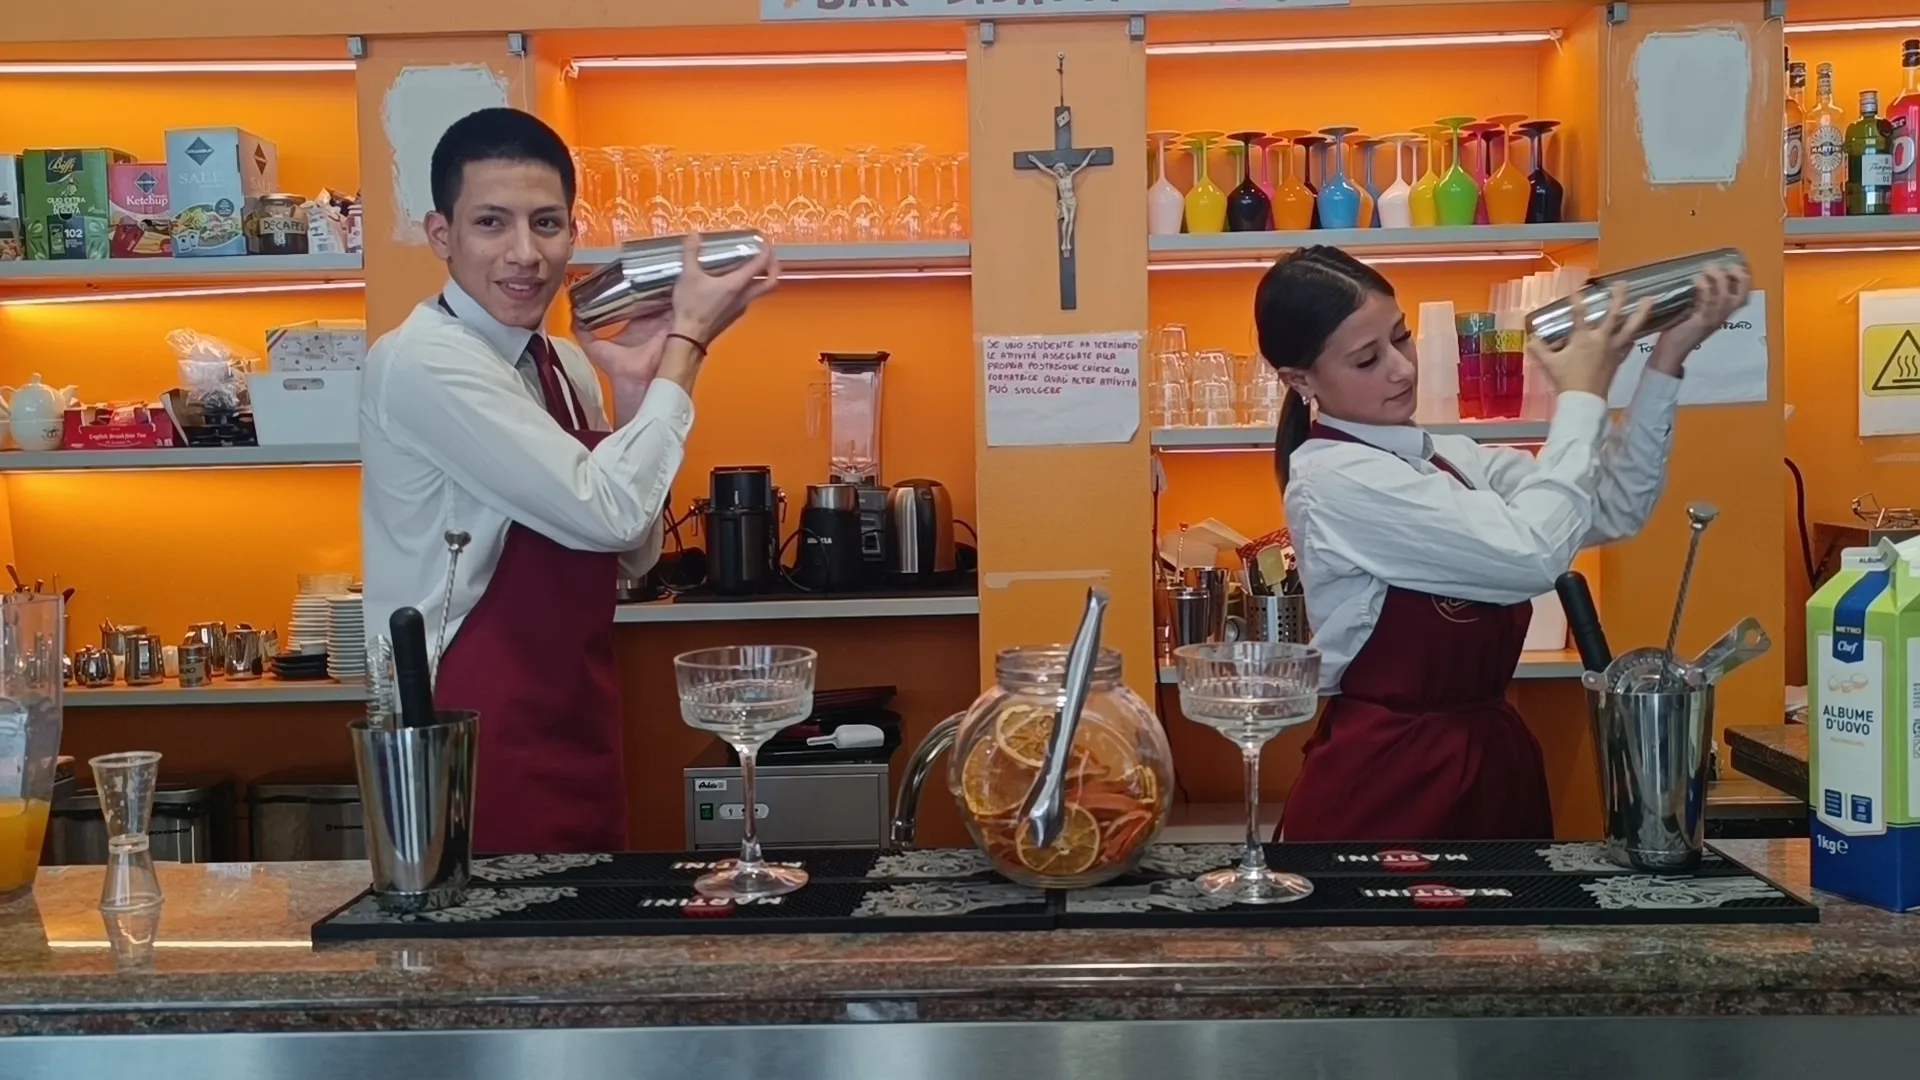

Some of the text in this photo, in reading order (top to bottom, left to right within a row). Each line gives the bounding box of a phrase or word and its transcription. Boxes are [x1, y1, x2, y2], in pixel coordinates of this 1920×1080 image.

[126, 195, 169, 207] Ketchup
[64, 229, 83, 238] 102
[1004, 341, 1024, 349] UNO
[1027, 340, 1074, 350] STUDENTE
[1042, 352, 1092, 360] ASSEGNATE
[1096, 352, 1116, 361] ALLA
[1028, 361, 1079, 370] POSTAZIONE
[988, 371, 1039, 381] FORMATRICE
[1835, 626, 1862, 634] METRO
[1837, 641, 1859, 655] Chef
[1823, 705, 1874, 723] ALBUME
[1826, 718, 1870, 736] D'UOVO
[1337, 854, 1469, 862] MARTINI
[1364, 888, 1513, 897] MARTINI
